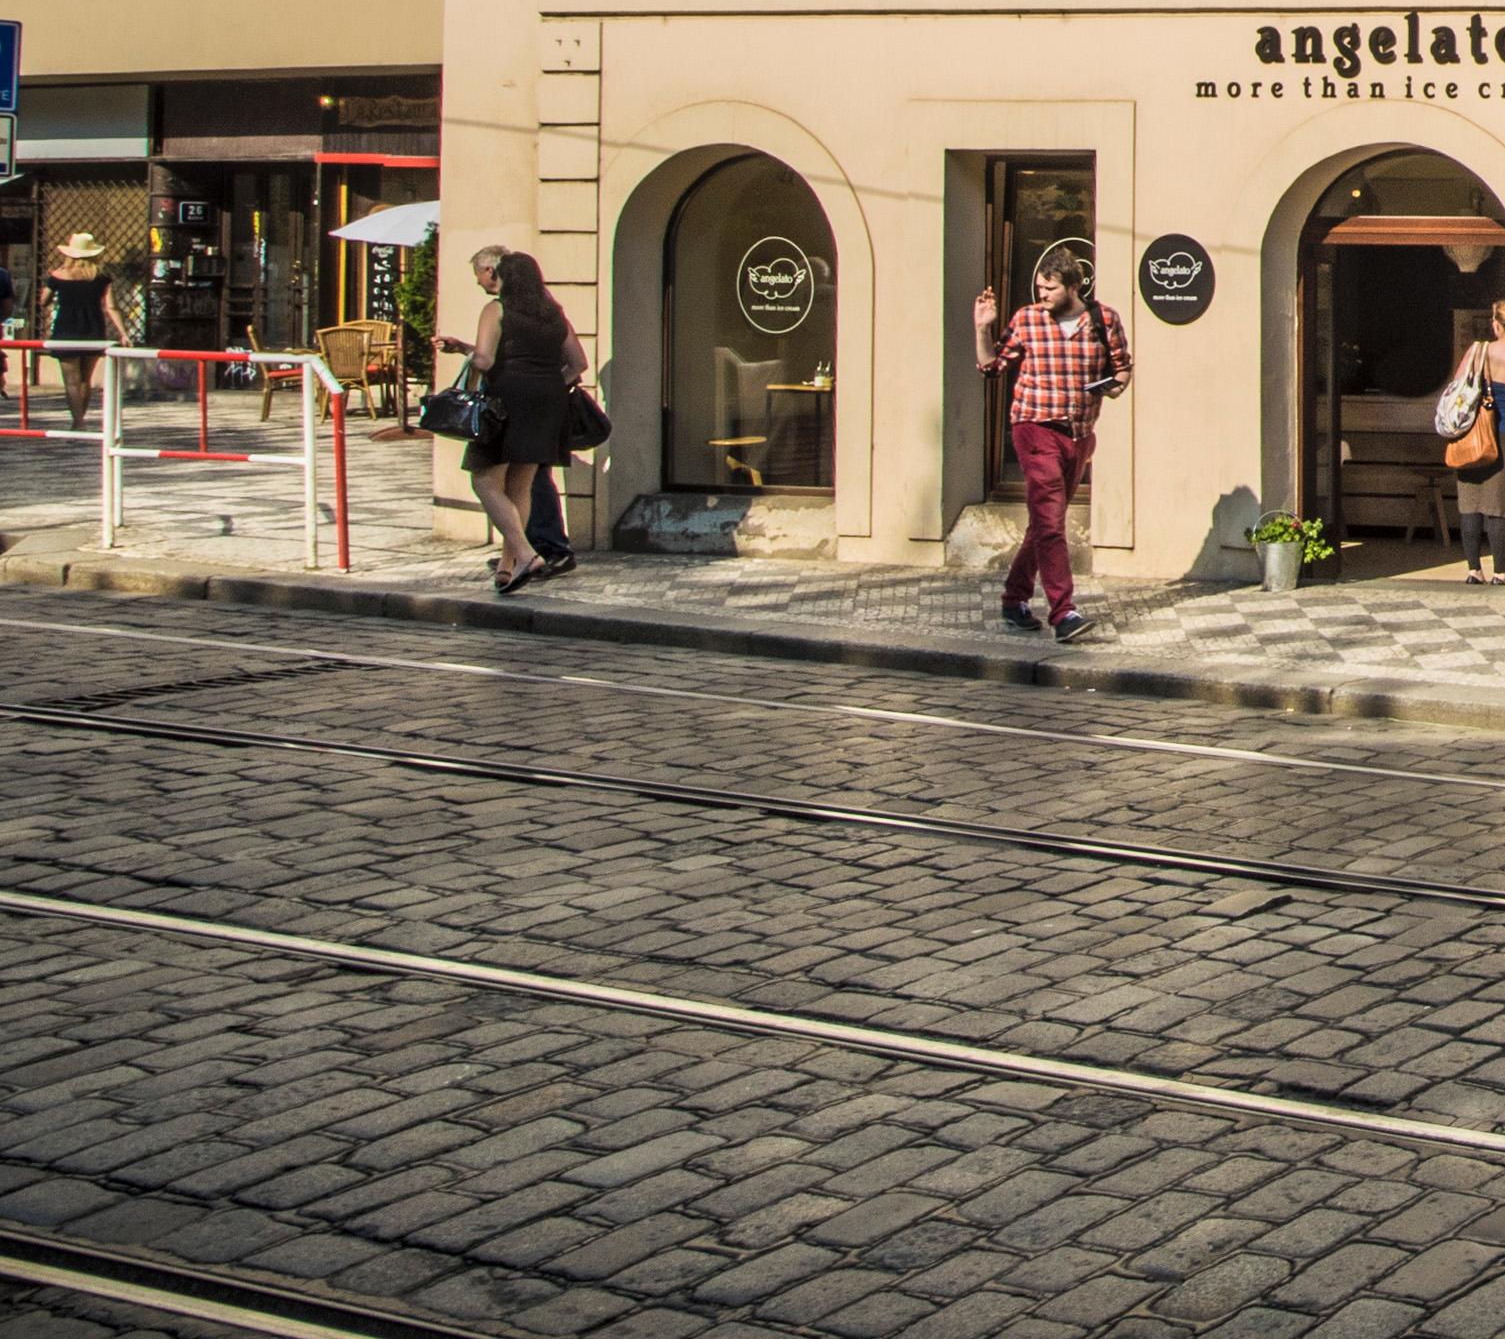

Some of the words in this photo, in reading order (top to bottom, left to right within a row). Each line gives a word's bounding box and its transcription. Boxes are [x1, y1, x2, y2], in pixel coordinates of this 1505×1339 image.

[1195, 80, 1284, 98] more
[1303, 76, 1386, 99] than
[1405, 76, 1459, 99] ice
[188, 205, 203, 216] 26
[1160, 265, 1191, 277] angelato
[760, 273, 793, 285] angelato
